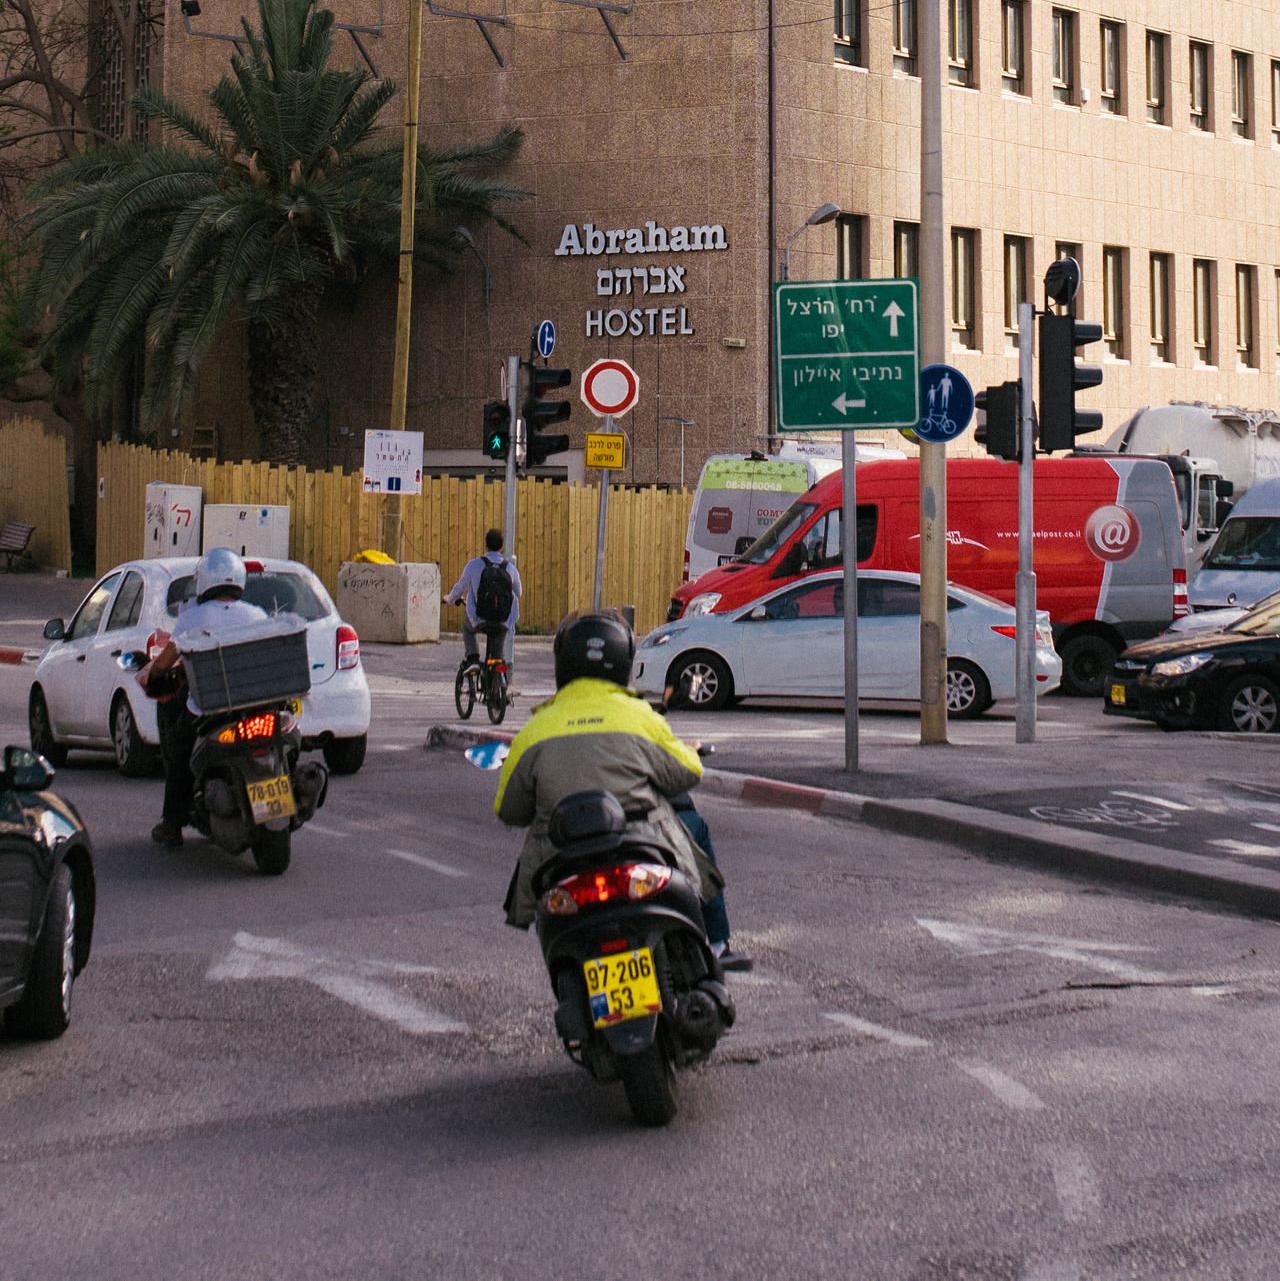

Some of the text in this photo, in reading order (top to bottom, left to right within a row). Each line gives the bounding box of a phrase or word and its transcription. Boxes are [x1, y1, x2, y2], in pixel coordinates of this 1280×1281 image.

[554, 221, 728, 256] Abraham
[596, 265, 686, 295] אברהם
[787, 298, 835, 316] הרצל
[586, 307, 693, 337] HOSTEL
[822, 324, 844, 338] יפו
[793, 365, 902, 387] נתיבי איילון
[610, 986, 634, 1012] 53
